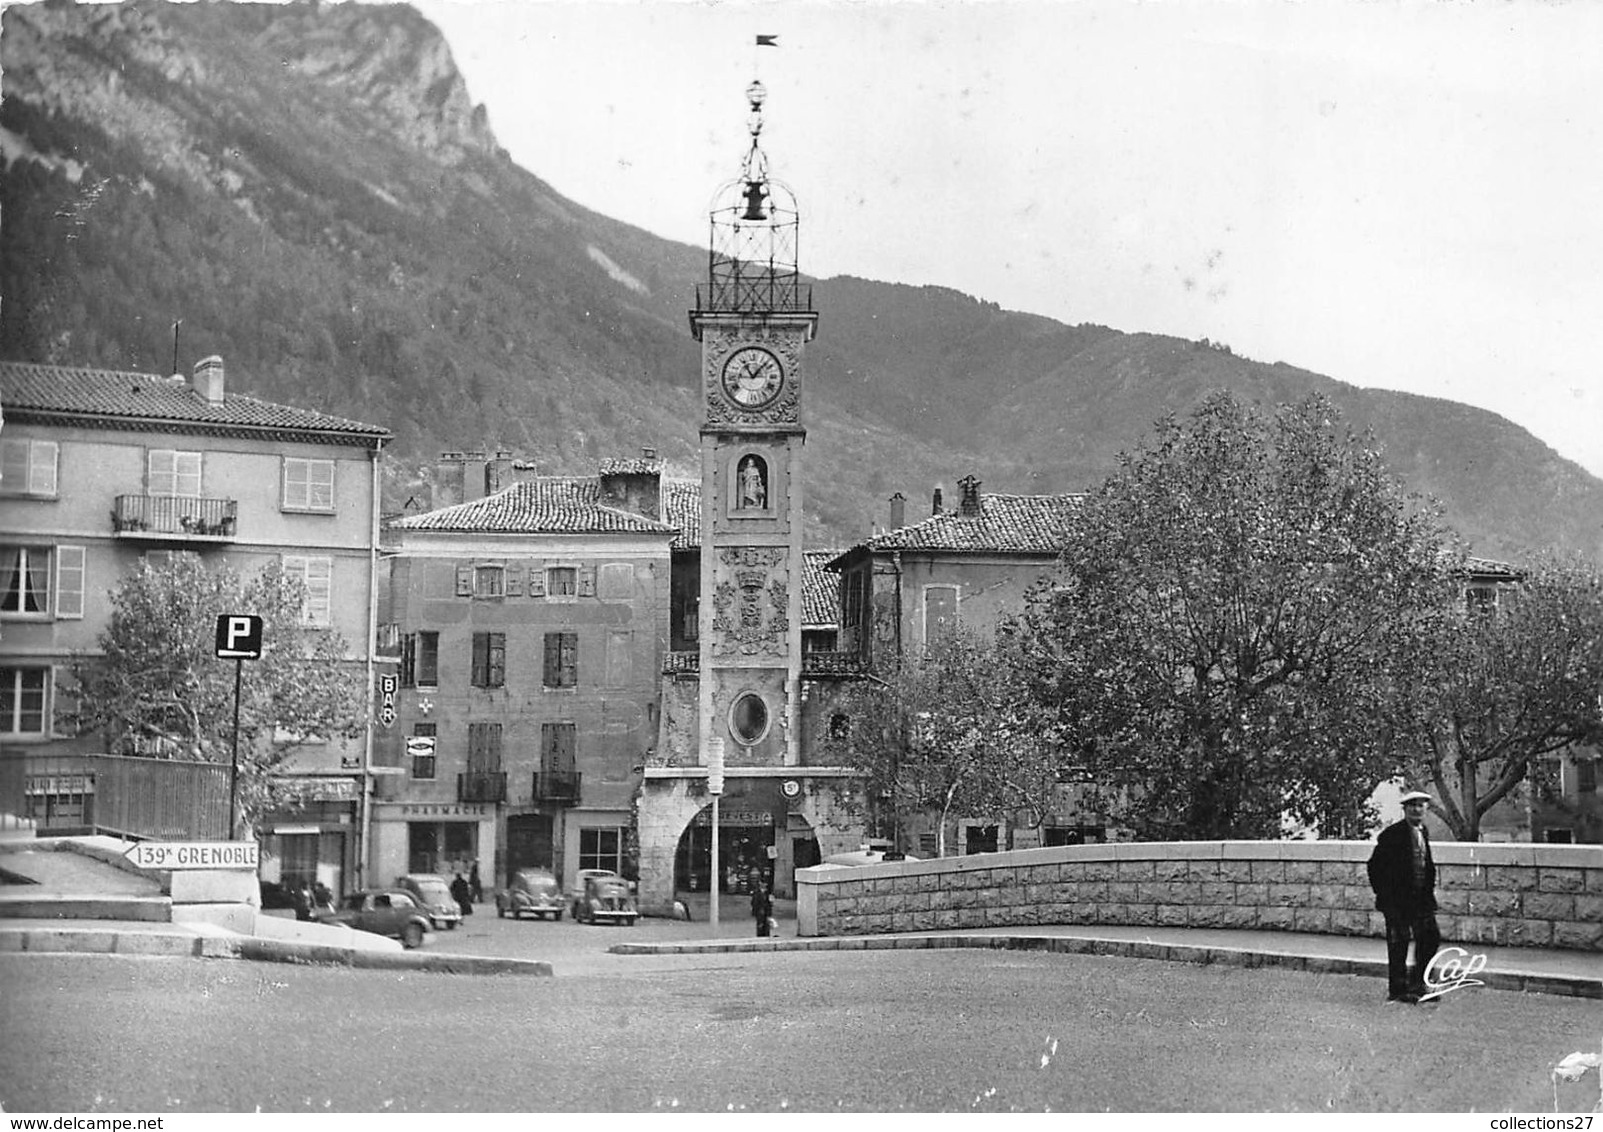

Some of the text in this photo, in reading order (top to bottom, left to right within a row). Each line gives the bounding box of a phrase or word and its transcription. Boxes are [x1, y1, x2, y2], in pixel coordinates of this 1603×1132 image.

[228, 617, 250, 649] P
[384, 679, 394, 721] BAR
[178, 847, 257, 864] GRENOBLE
